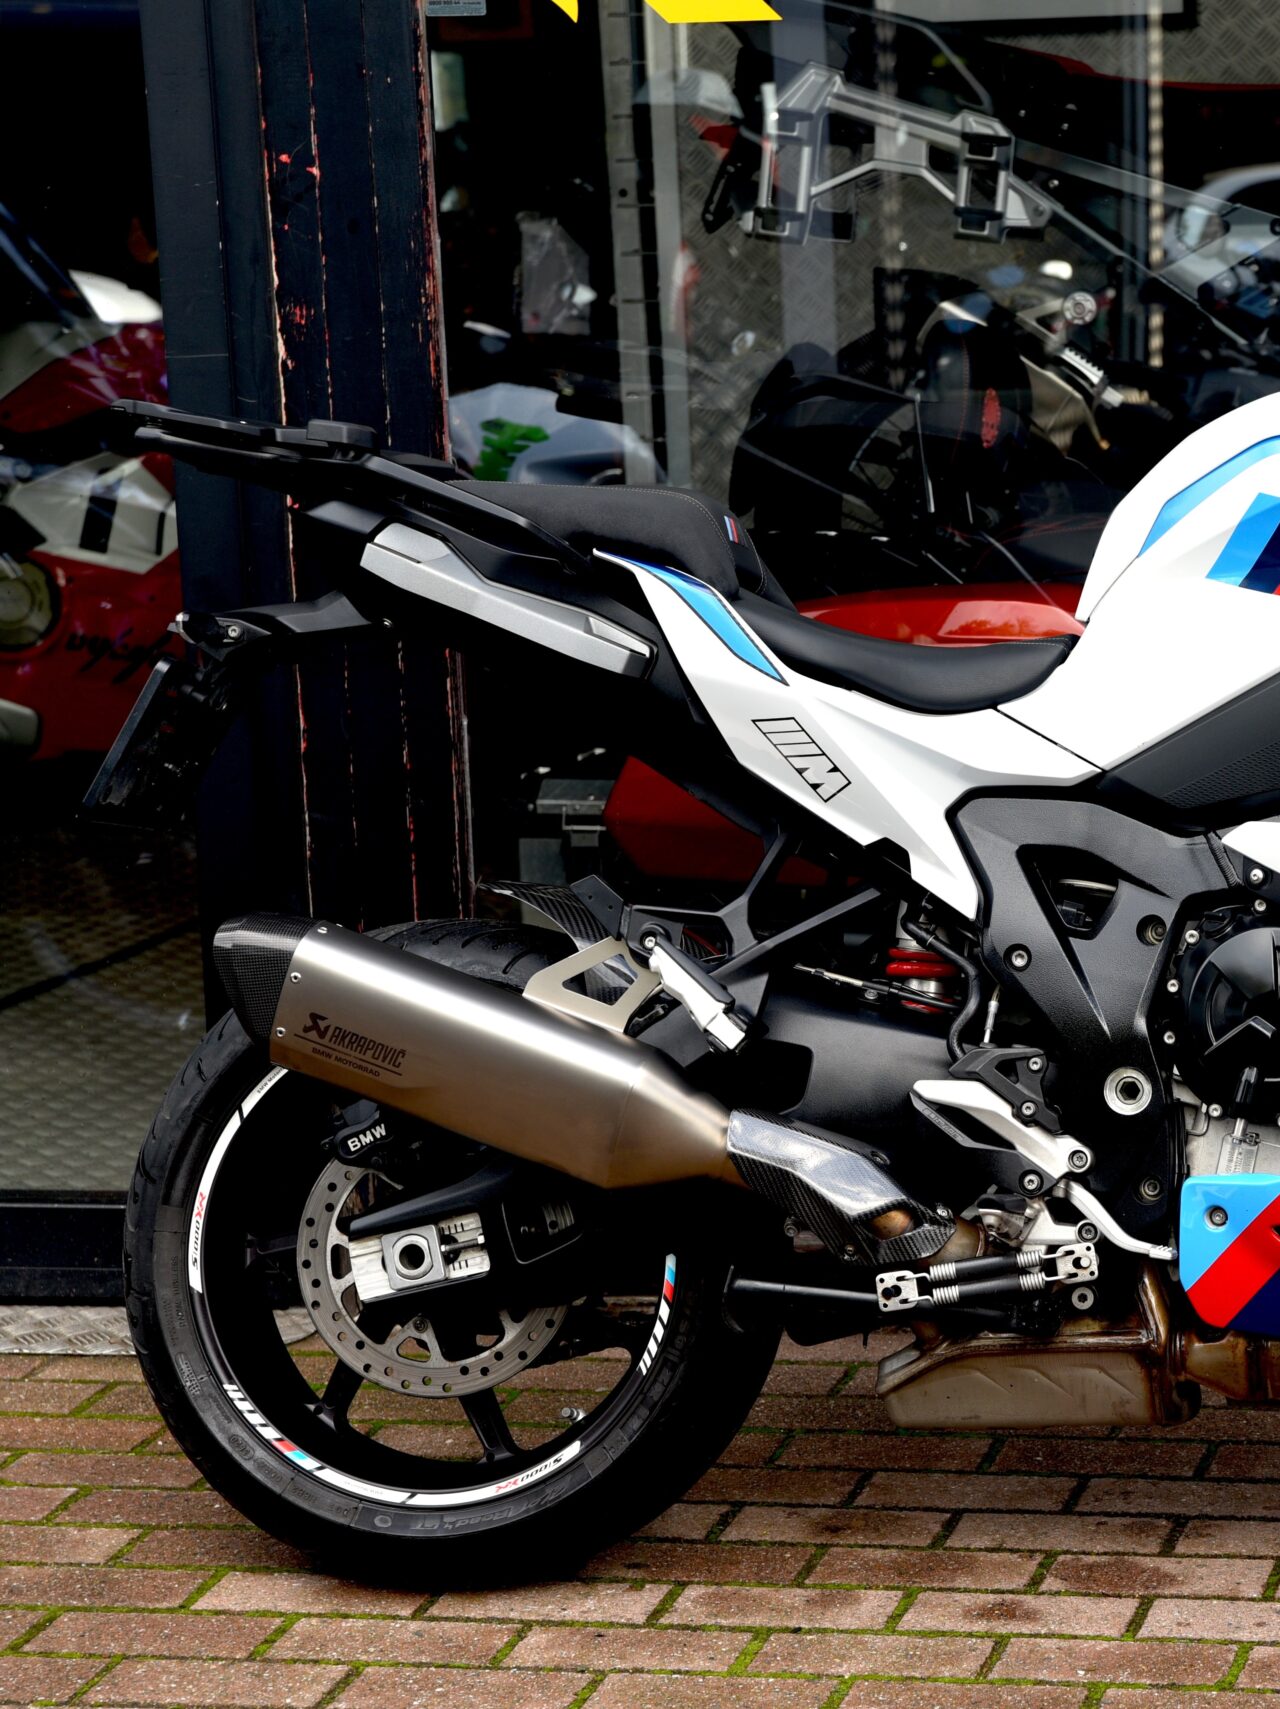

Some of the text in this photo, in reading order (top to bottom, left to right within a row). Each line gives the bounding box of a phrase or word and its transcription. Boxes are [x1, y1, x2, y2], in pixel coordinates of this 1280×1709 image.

[328, 1026, 407, 1068] AKRAPOVIČ
[312, 1047, 380, 1077] BMW MOTORRAD
[256, 1081, 269, 1093] BMW
[347, 1123, 387, 1152] BMW
